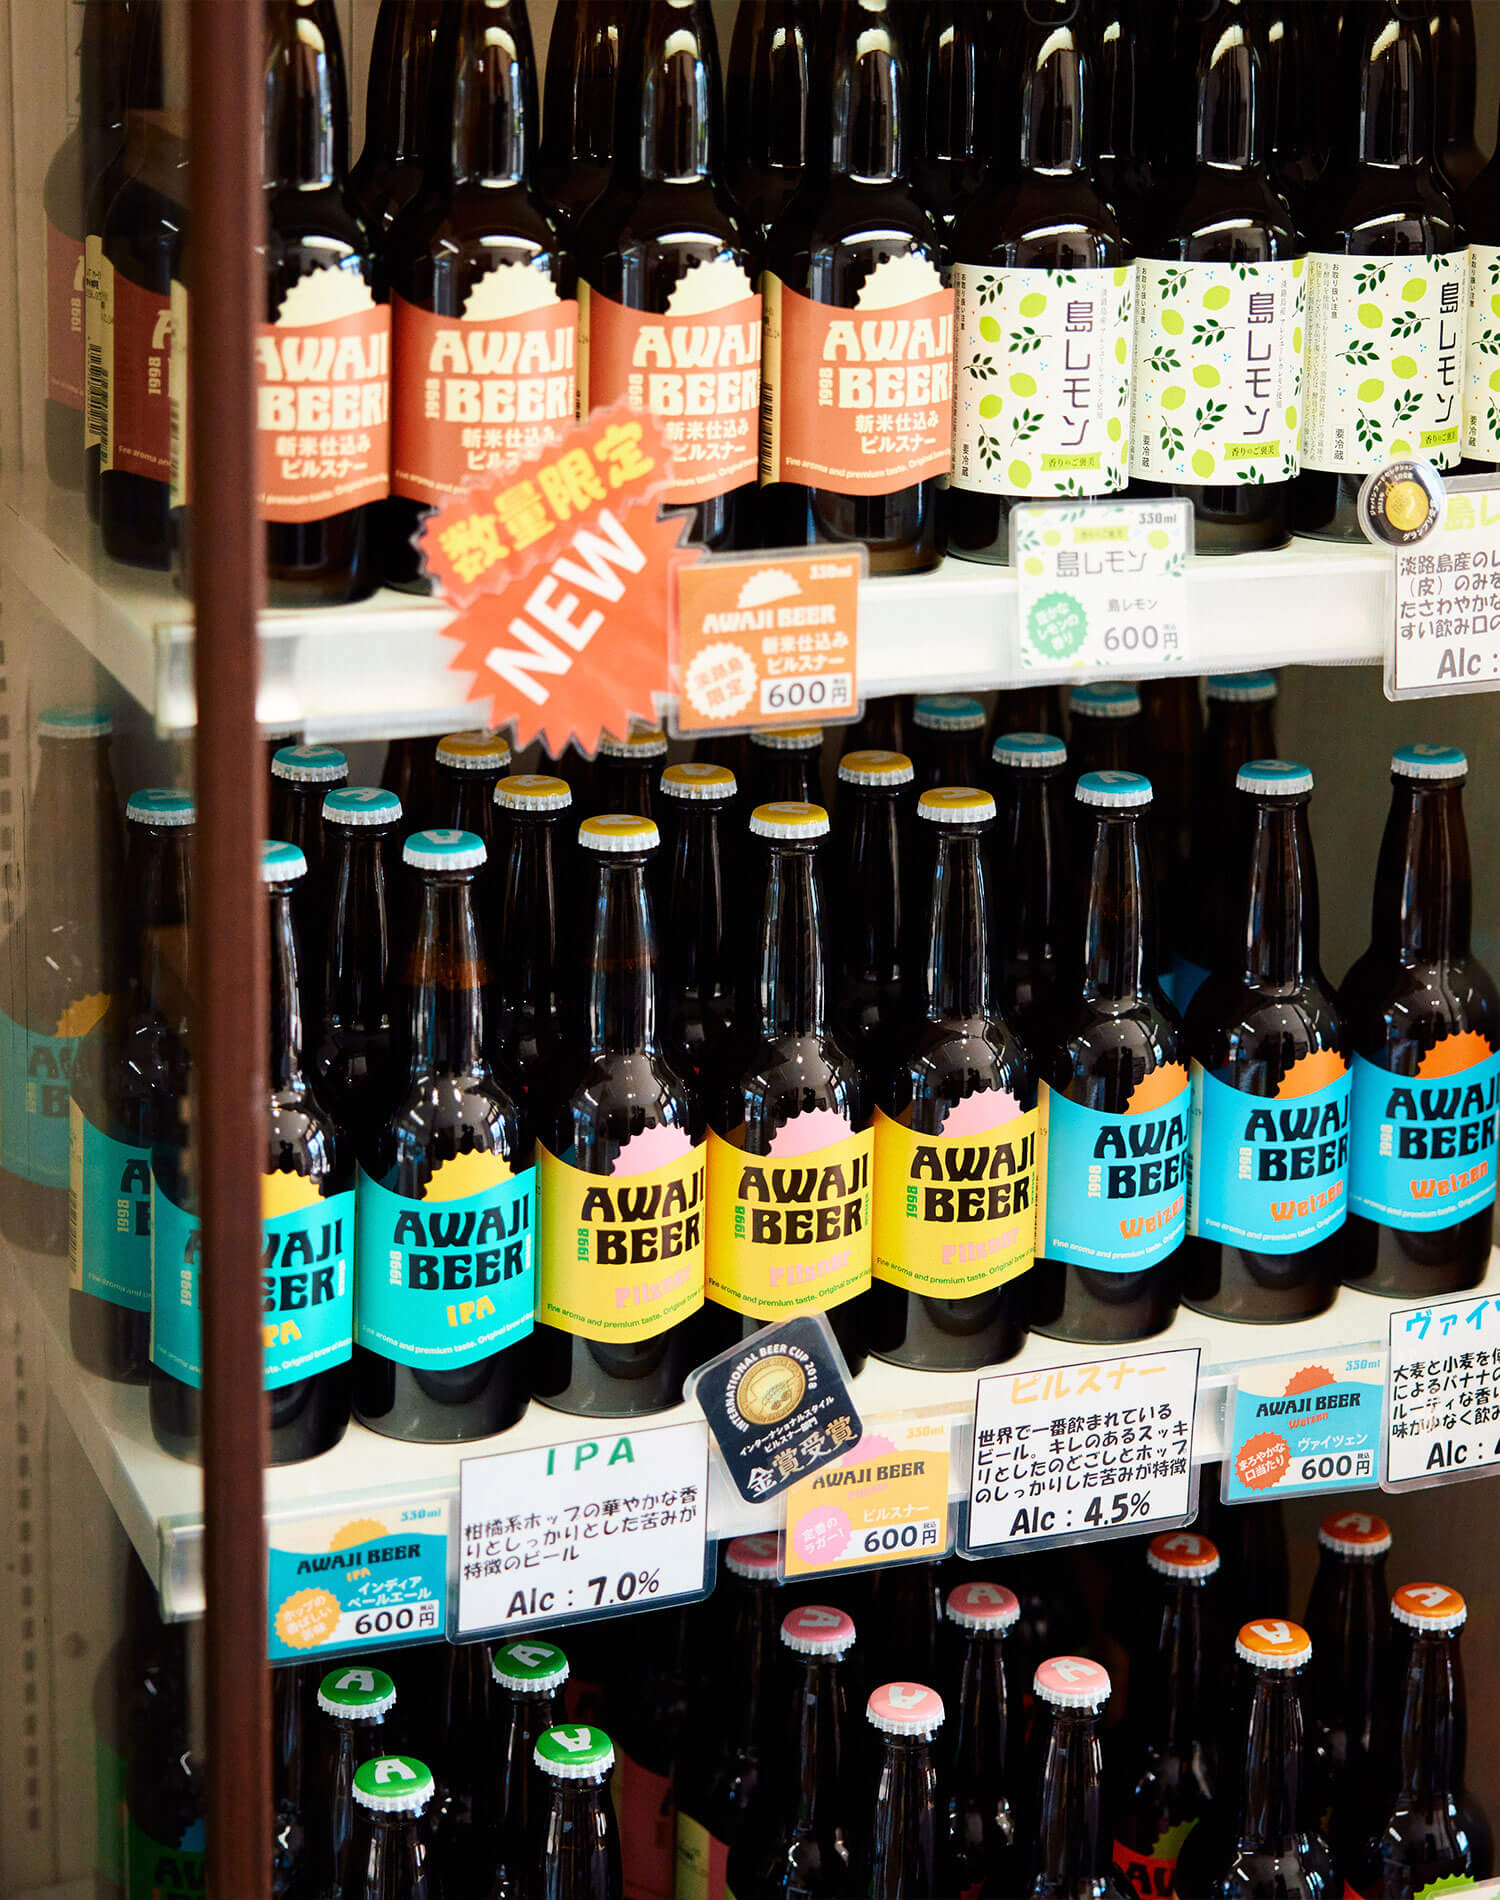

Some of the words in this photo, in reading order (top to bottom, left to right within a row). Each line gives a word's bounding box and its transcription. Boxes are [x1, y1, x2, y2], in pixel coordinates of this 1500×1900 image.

[429, 326, 575, 375] AWAJI
[632, 320, 761, 368] AWAJI
[823, 314, 953, 361] AWAJI
[1434, 282, 1459, 424] 島レモン
[257, 331, 388, 382] AWAJI
[1060, 299, 1094, 446] 島レモン
[1242, 292, 1275, 435] 島レモン
[148, 356, 161, 395] 1998
[819, 367, 833, 407] 1998
[838, 362, 948, 408] BEER
[258, 382, 380, 431] BEER
[445, 375, 568, 423] BEER
[649, 370, 757, 416] BEER
[665, 417, 749, 441] 新米仕込み
[856, 410, 939, 434] 新米仕込み
[276, 433, 372, 457] 新米仕込み
[671, 441, 747, 462] ピルスナー
[861, 433, 937, 454] ピルスナー
[1334, 428, 1345, 461] 要冷蔵
[281, 457, 368, 480] ピルスナー
[438, 422, 655, 583] 数量限定
[1139, 512, 1177, 525] 330ml
[1056, 550, 1147, 578] 島レモン
[485, 508, 648, 705] NEW
[702, 609, 774, 635] AWAJI
[777, 604, 837, 628] BEER
[1108, 598, 1158, 613] 島レモン
[1104, 624, 1179, 651] 600円
[767, 654, 845, 675] ピルスナー
[1437, 647, 1482, 679] Alc
[769, 680, 847, 708] 600円
[1398, 1114, 1495, 1159] BEER
[910, 1131, 1035, 1182] AWAJI
[1239, 1147, 1252, 1180] 1998
[1258, 1132, 1348, 1181] BEER
[581, 1166, 705, 1222] AWAJI
[738, 1152, 869, 1204] AWAJI
[1088, 1165, 1102, 1198] 1998
[1410, 1160, 1488, 1200] Weizen
[906, 1184, 918, 1219] 1998
[924, 1176, 1030, 1222] BEER
[1270, 1179, 1343, 1222] Weizen
[117, 1199, 129, 1233] 1998
[394, 1192, 530, 1248] AWAJI
[734, 1205, 746, 1240] 1998
[752, 1198, 862, 1245] BEER
[578, 1227, 589, 1262] 1998
[596, 1211, 700, 1265] BEER
[942, 1226, 1020, 1265] Pilsner
[390, 1250, 402, 1286] 1998
[408, 1240, 524, 1290] BEER
[769, 1249, 850, 1288] Pilsner
[876, 1256, 889, 1267] Fine
[891, 1263, 912, 1277] aroma
[914, 1272, 929, 1281] and
[930, 1276, 966, 1284] premium
[967, 1271, 987, 1282] taste.
[180, 1269, 192, 1307] 1998
[615, 1264, 691, 1309] Pilsner
[708, 1276, 720, 1288] Fine
[721, 1284, 742, 1299] aroma
[742, 1294, 757, 1303] and
[758, 1298, 794, 1307] premium
[818, 1280, 845, 1297] Original
[447, 1295, 496, 1327] IPA
[547, 1302, 561, 1313] Fine
[561, 1308, 586, 1322] aroma
[587, 1317, 603, 1327] and
[604, 1320, 640, 1329] premium
[641, 1313, 662, 1325] taste.
[1406, 1299, 1500, 1340] ヴァイ
[375, 1331, 398, 1347] aroma
[399, 1341, 415, 1353] and
[415, 1346, 453, 1355] premium
[1345, 1359, 1381, 1371] 330ml
[725, 1352, 759, 1433] INTERNATIONAL
[758, 1343, 788, 1358] BEER
[788, 1345, 809, 1363] CUP
[804, 1360, 819, 1390] 2018
[1256, 1397, 1312, 1417] AWAJI
[1315, 1392, 1361, 1411] BEER
[739, 1395, 835, 1457] インターナショナルスタイル
[763, 1415, 819, 1453] ピルスナー部門
[906, 1425, 944, 1440] 330ml
[978, 1402, 1172, 1448] 世界で一番飲まれている
[1288, 1412, 1329, 1429] Weizen
[747, 1415, 858, 1498] 金賞受賞
[1238, 1443, 1287, 1471] まろやかな
[1297, 1433, 1368, 1452] ヴァイツェン
[1426, 1439, 1468, 1470] Alc
[812, 1468, 872, 1490] AWAJI
[876, 1461, 926, 1482] BEER
[975, 1458, 1187, 1503] のしっかりした苦みが特徴
[1245, 1455, 1285, 1482] 口当たり
[1301, 1455, 1370, 1480] 600円
[1009, 1506, 1056, 1537] Alc
[1084, 1490, 1151, 1527] 4.5%
[1336, 1513, 1373, 1535] A
[466, 1505, 697, 1560] りとしっかりとした苦みが
[864, 1525, 937, 1553] 600円
[1163, 1533, 1201, 1556] A
[296, 1551, 363, 1575] AWAJI
[367, 1543, 421, 1564] BEER
[346, 1567, 371, 1583] IPA
[464, 1544, 580, 1581] 特徴のビール
[347, 1587, 432, 1608] ペールエール
[358, 1575, 423, 1596] インディア
[505, 1587, 555, 1619] Alc
[587, 1567, 661, 1607] 7.0%
[967, 1584, 1004, 1604] A
[355, 1608, 435, 1635] 600円
[1249, 1621, 1294, 1645] A
[508, 1644, 555, 1668] A
[1050, 1658, 1099, 1682] A
[335, 1669, 375, 1692] A
[550, 1727, 593, 1753] A
[374, 1757, 417, 1784] A
